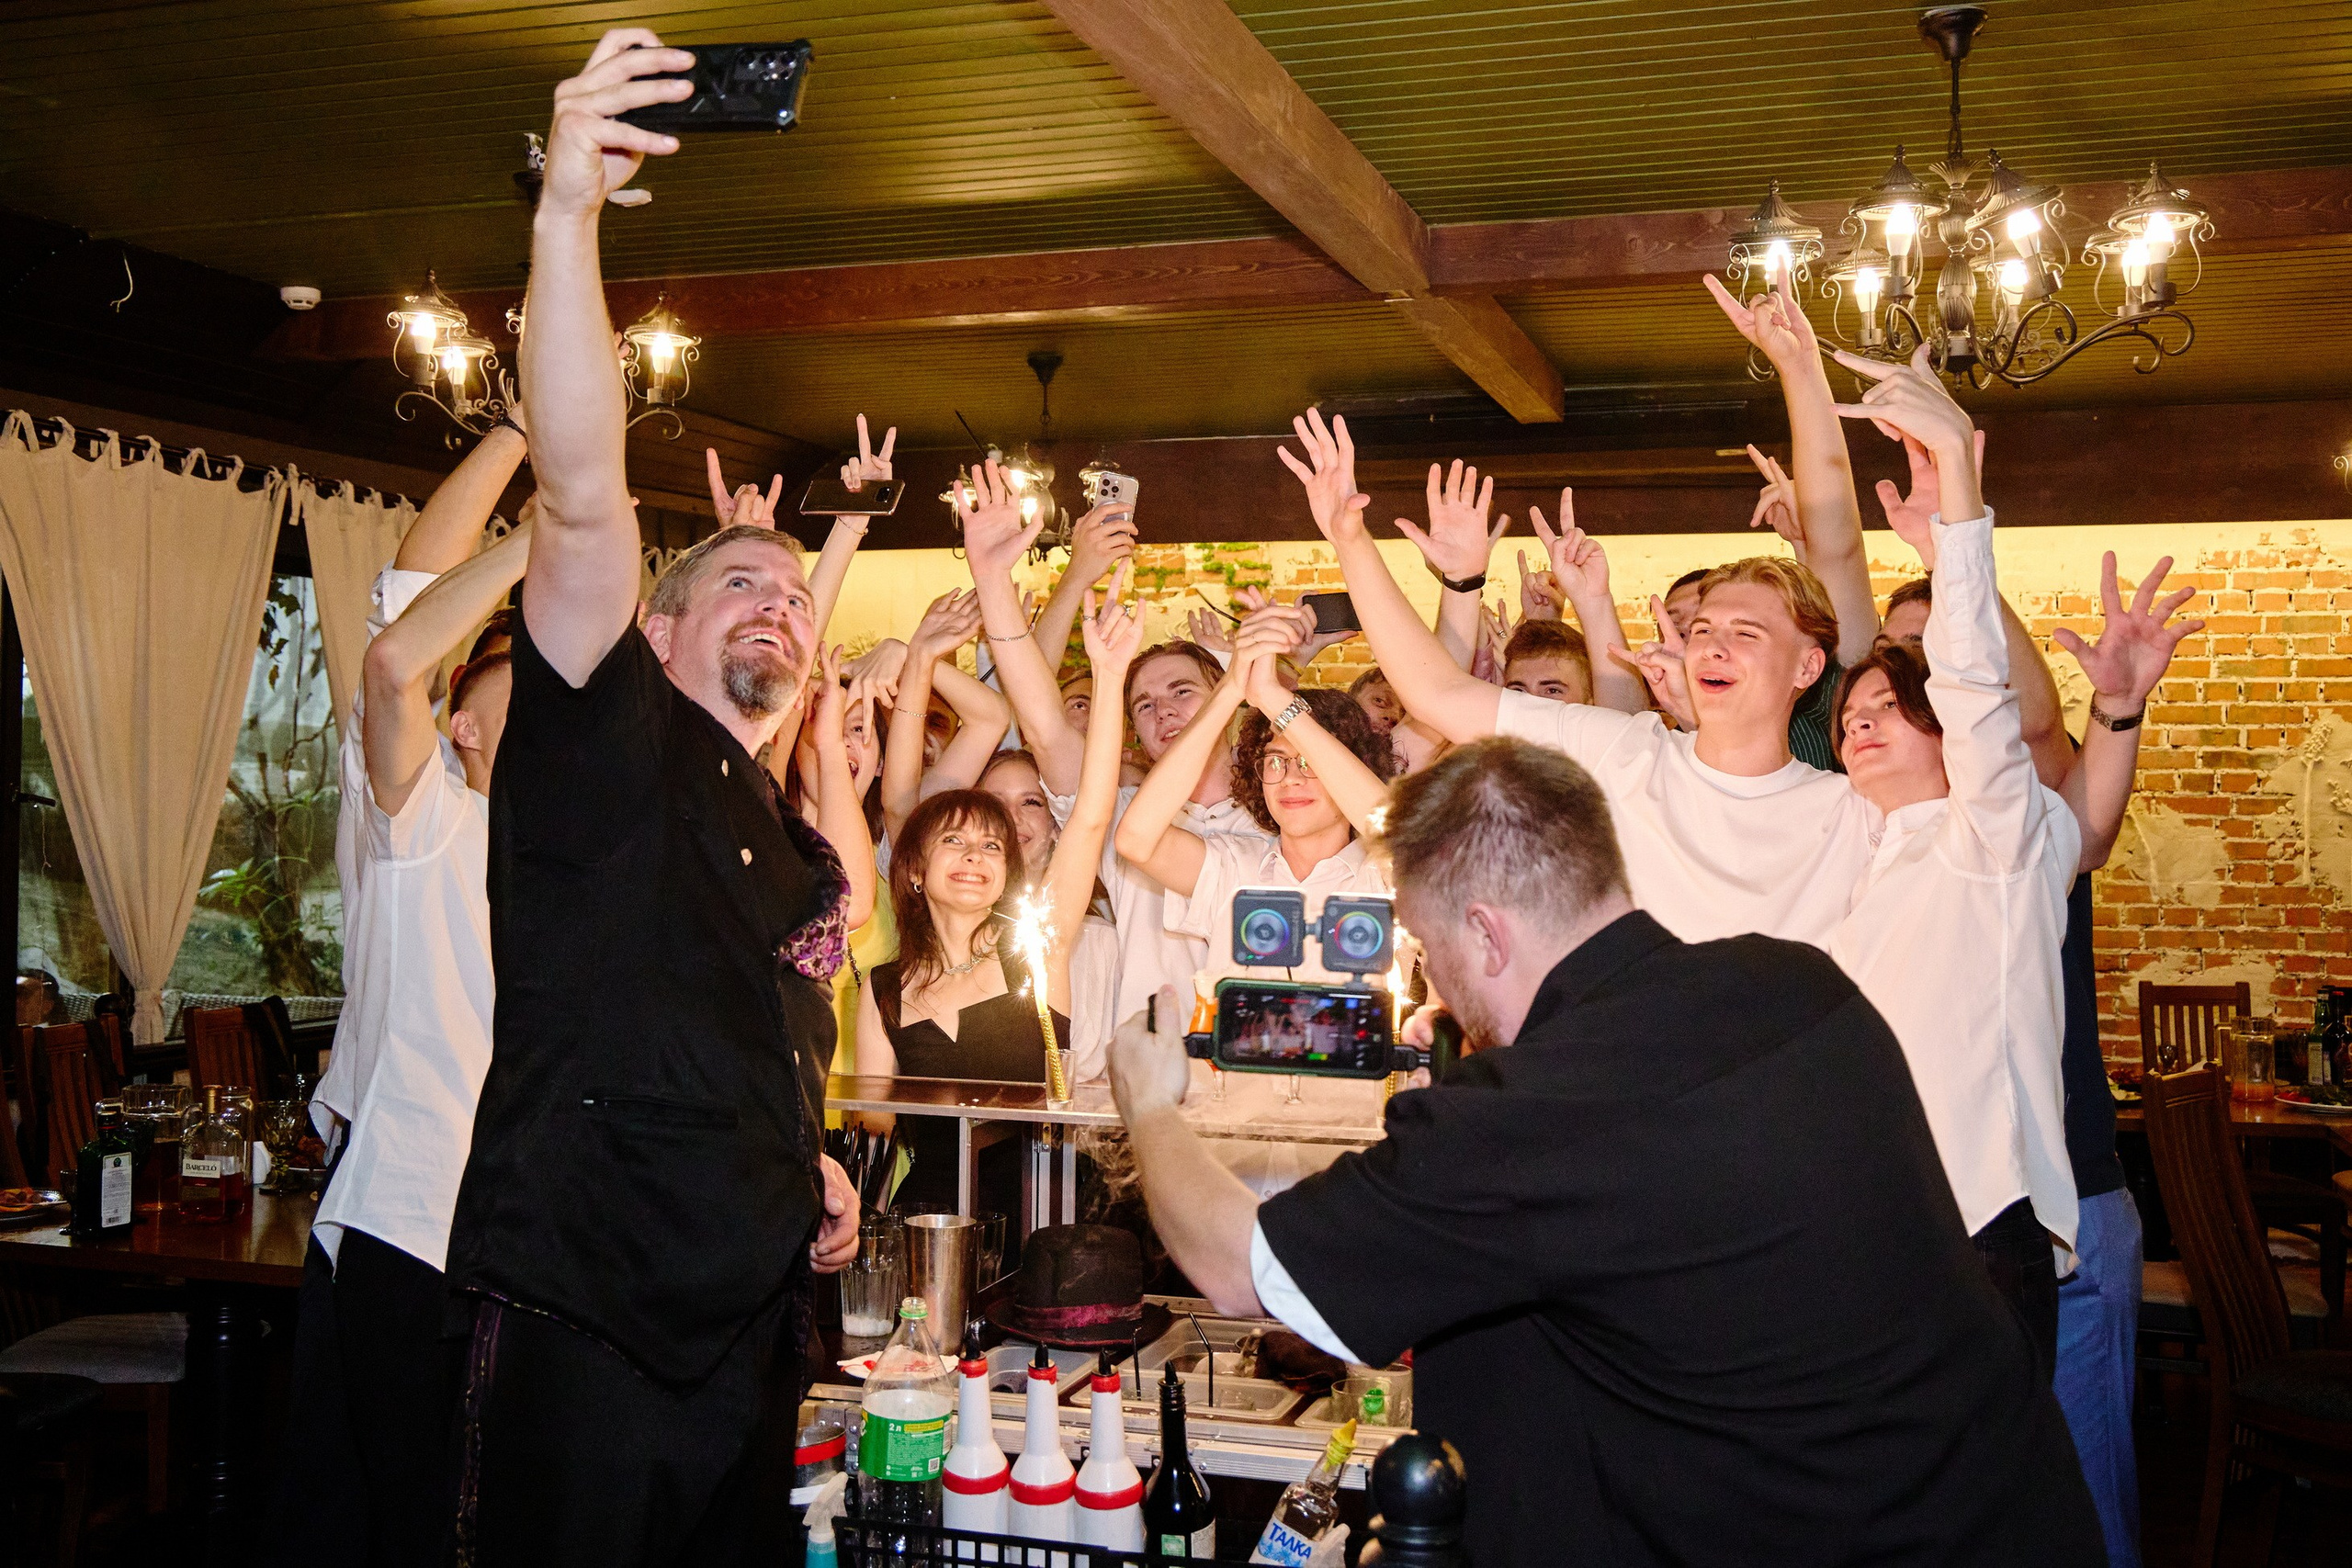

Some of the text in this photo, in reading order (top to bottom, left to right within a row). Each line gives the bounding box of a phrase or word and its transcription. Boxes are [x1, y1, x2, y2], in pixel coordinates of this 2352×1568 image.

[186, 1163, 217, 1171] BARCELÓ
[888, 1423, 895, 1431] 2
[1269, 1522, 1312, 1559] ТАЛКА
